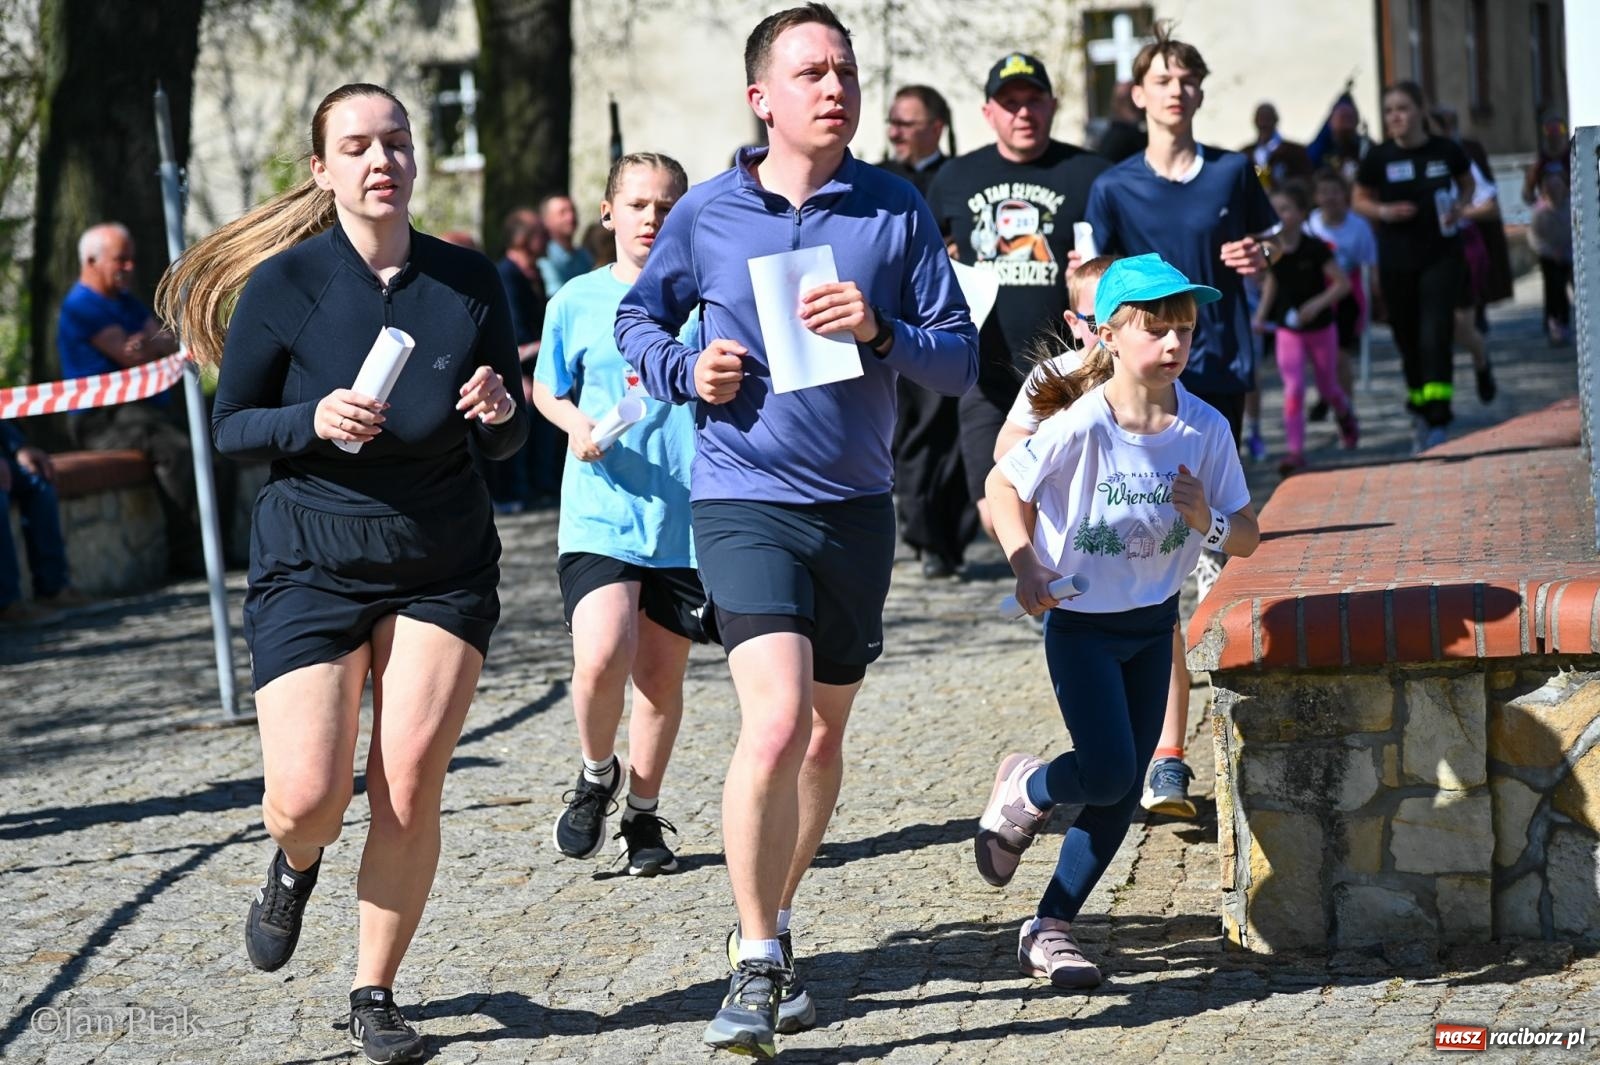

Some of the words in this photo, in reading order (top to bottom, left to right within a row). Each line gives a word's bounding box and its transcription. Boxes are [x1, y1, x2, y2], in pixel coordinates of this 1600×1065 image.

[968, 193, 987, 213] CO
[984, 183, 1010, 204] TAM
[1097, 482, 1174, 506] Wierchle
[1208, 516, 1225, 544] 178
